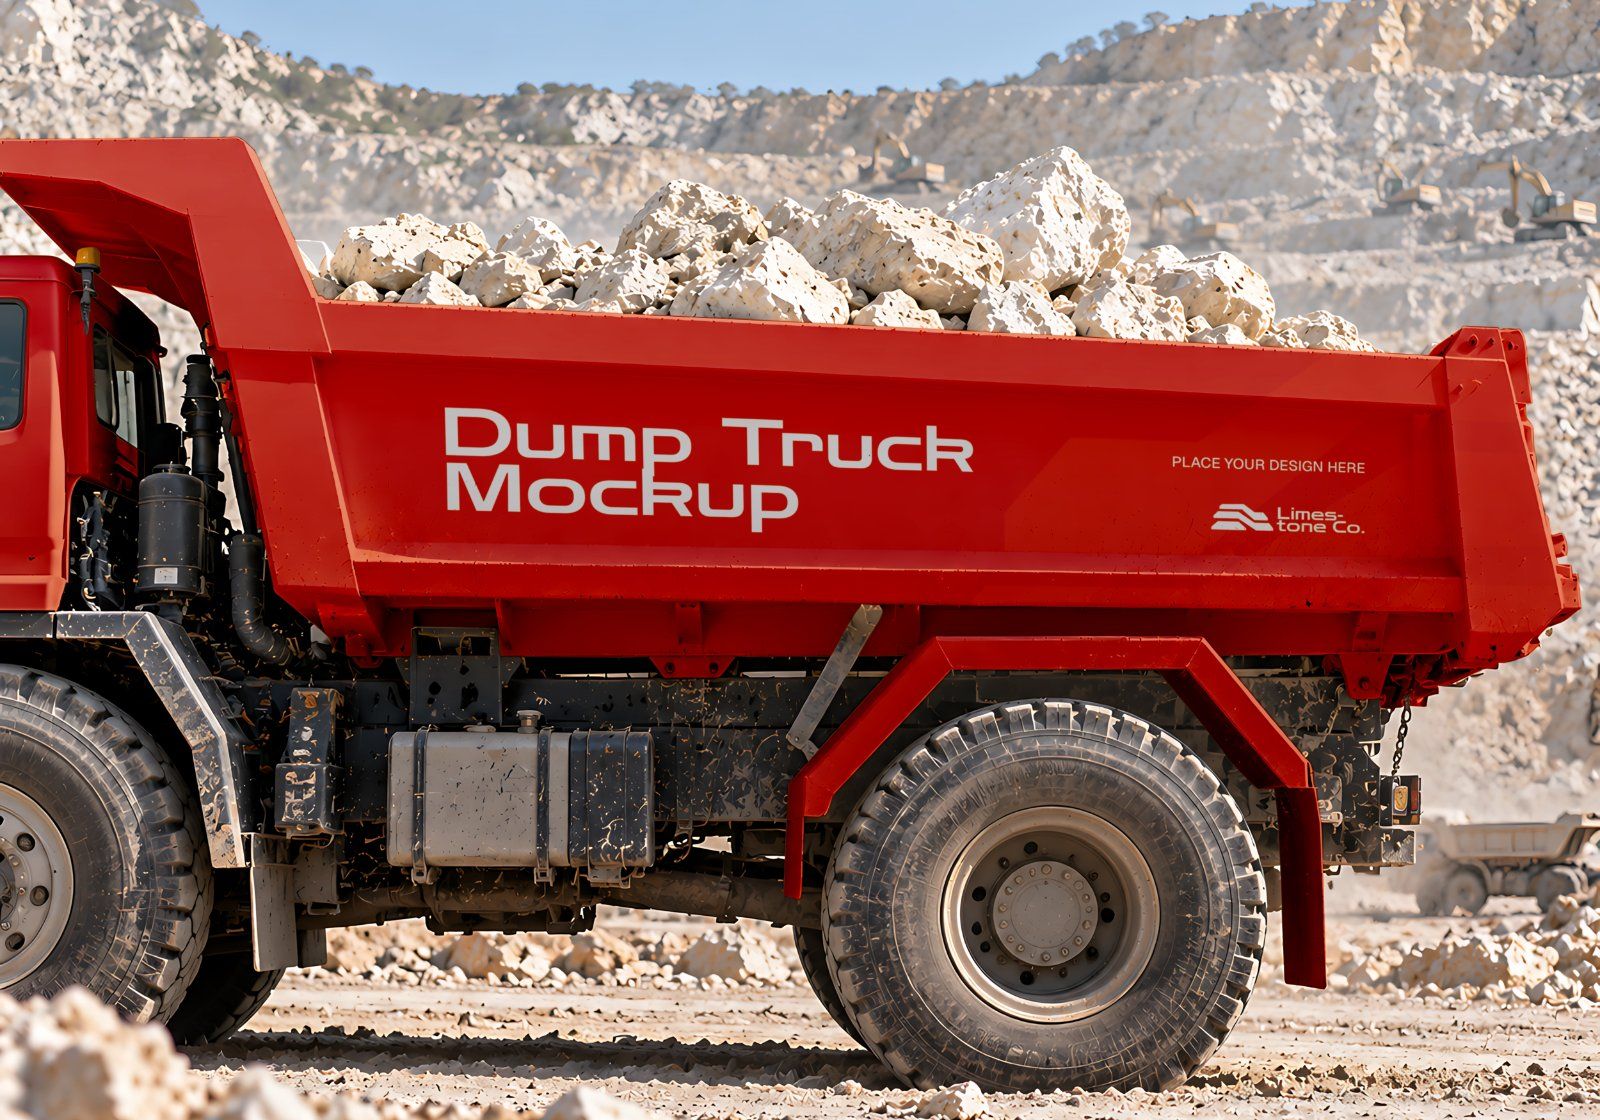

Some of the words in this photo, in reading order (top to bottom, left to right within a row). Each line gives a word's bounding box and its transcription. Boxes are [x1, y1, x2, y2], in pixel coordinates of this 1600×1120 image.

[444, 407, 693, 477] Dump
[721, 417, 975, 472] Truck
[1172, 456, 1221, 469] PLACE
[1224, 458, 1265, 471] YOUR
[1269, 459, 1323, 473] DESIGN
[1327, 461, 1366, 474] HERE
[446, 462, 799, 533] Mockup
[1277, 506, 1344, 521] Limes-
[1276, 520, 1327, 533] tone
[1332, 520, 1366, 534] Co.
